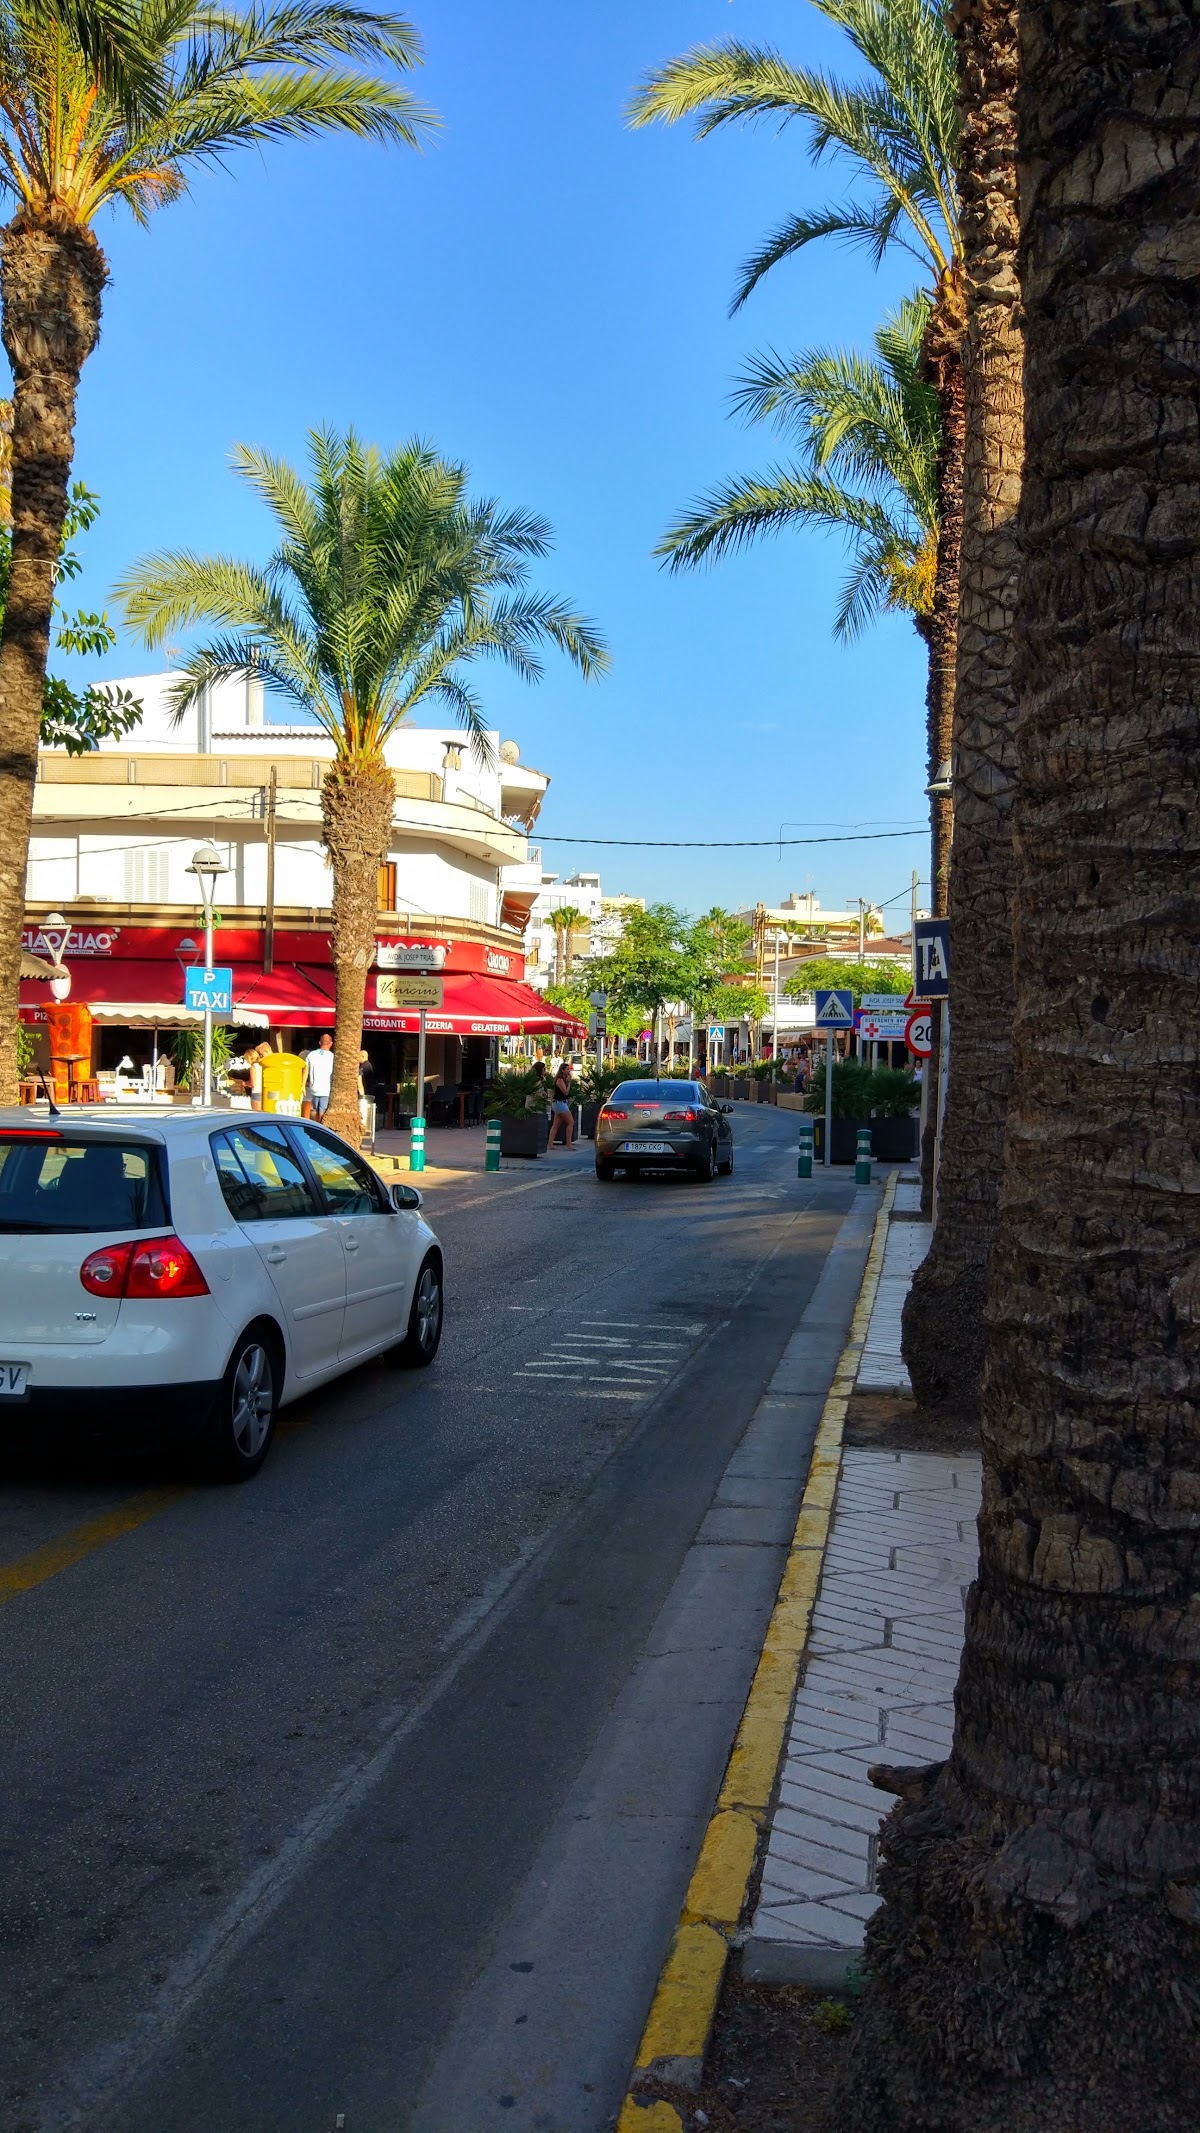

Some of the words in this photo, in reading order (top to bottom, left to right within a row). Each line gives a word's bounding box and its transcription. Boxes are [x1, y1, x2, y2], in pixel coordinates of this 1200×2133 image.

[21, 932, 61, 948] CIAO
[66, 933, 111, 949] CIAO
[404, 953, 419, 962] JOSEP
[420, 954, 435, 962] TRIAS
[917, 937, 948, 980] TA
[204, 972, 216, 984] P
[380, 980, 440, 996] Vinicius
[189, 990, 228, 1009] TAXI
[34, 1012, 48, 1020] PIZ
[362, 1018, 406, 1029] ISTORANTE
[425, 1021, 453, 1031] IZZERIA
[471, 1023, 510, 1033] GELATERIA
[914, 1025, 932, 1041] 20
[631, 1143, 647, 1151] 1875
[648, 1143, 662, 1151] CKG
[74, 1312, 97, 1321] TDI
